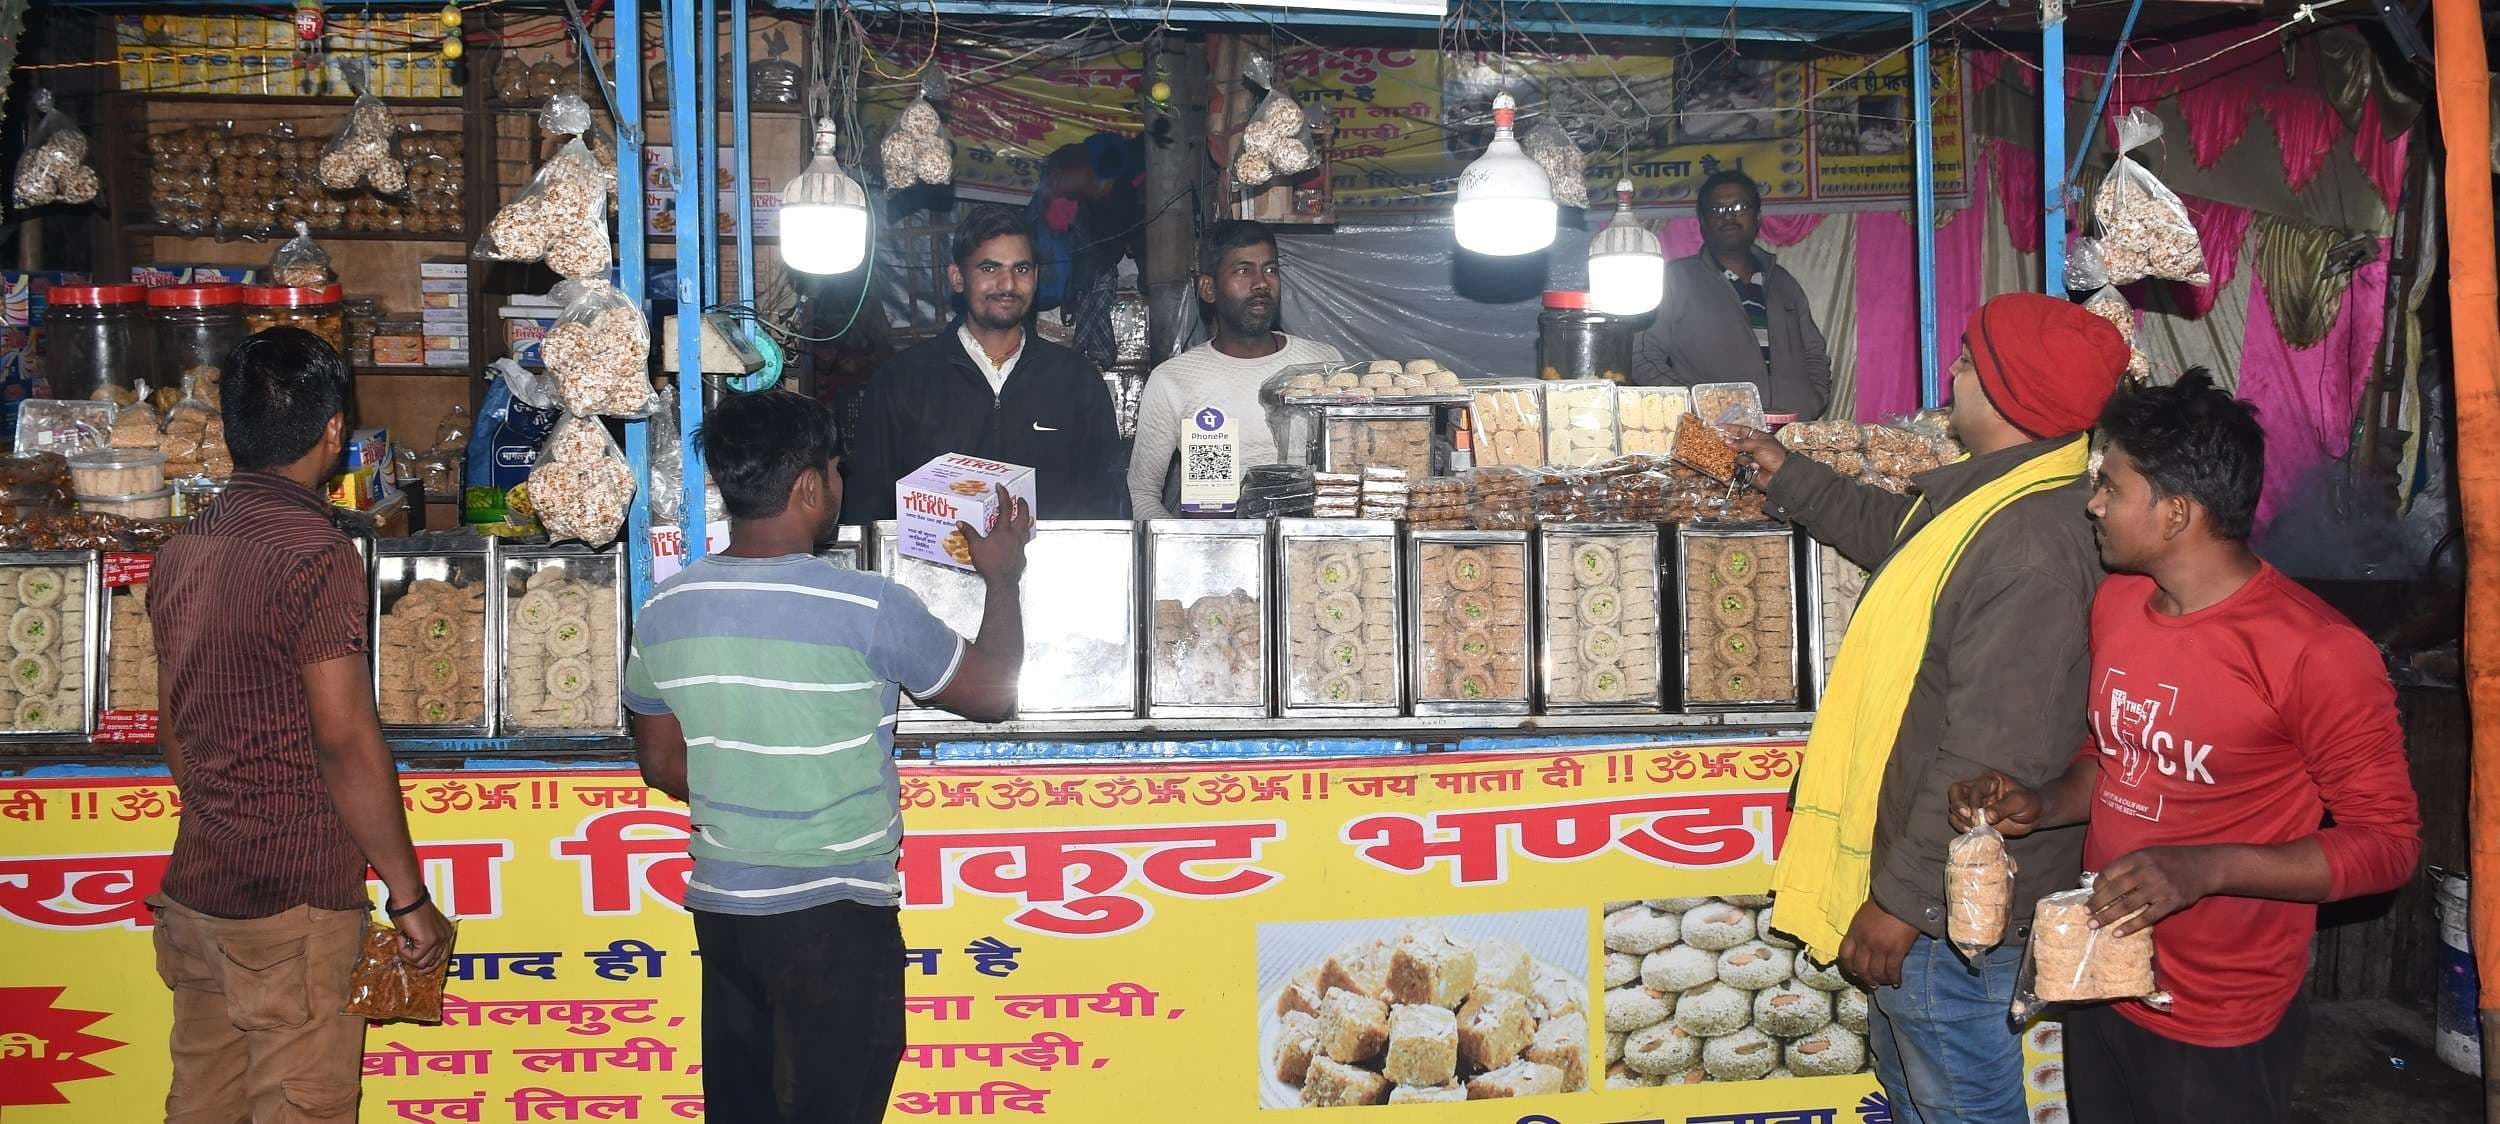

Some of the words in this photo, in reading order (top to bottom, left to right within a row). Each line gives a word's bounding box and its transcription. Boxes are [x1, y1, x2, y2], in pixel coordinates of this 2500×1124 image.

[1191, 432, 1229, 440] PhonePe
[903, 495, 959, 519] TILKUT
[911, 491, 948, 507] SPECIAL
[2126, 701, 2143, 714] THE
[1342, 775, 1418, 798] जय
[1431, 768, 1524, 794] माता
[1536, 757, 1585, 787] दी
[0, 789, 48, 822] दी
[572, 786, 650, 809] जय
[1347, 791, 1791, 884] भण्डा
[446, 951, 563, 981] वाद
[584, 939, 667, 982] ही
[964, 935, 1022, 978] है
[994, 981, 1186, 1020] लायी,
[387, 1090, 487, 1124] एवं
[504, 1086, 643, 1121] तिल
[892, 1079, 1052, 1116] आदि
